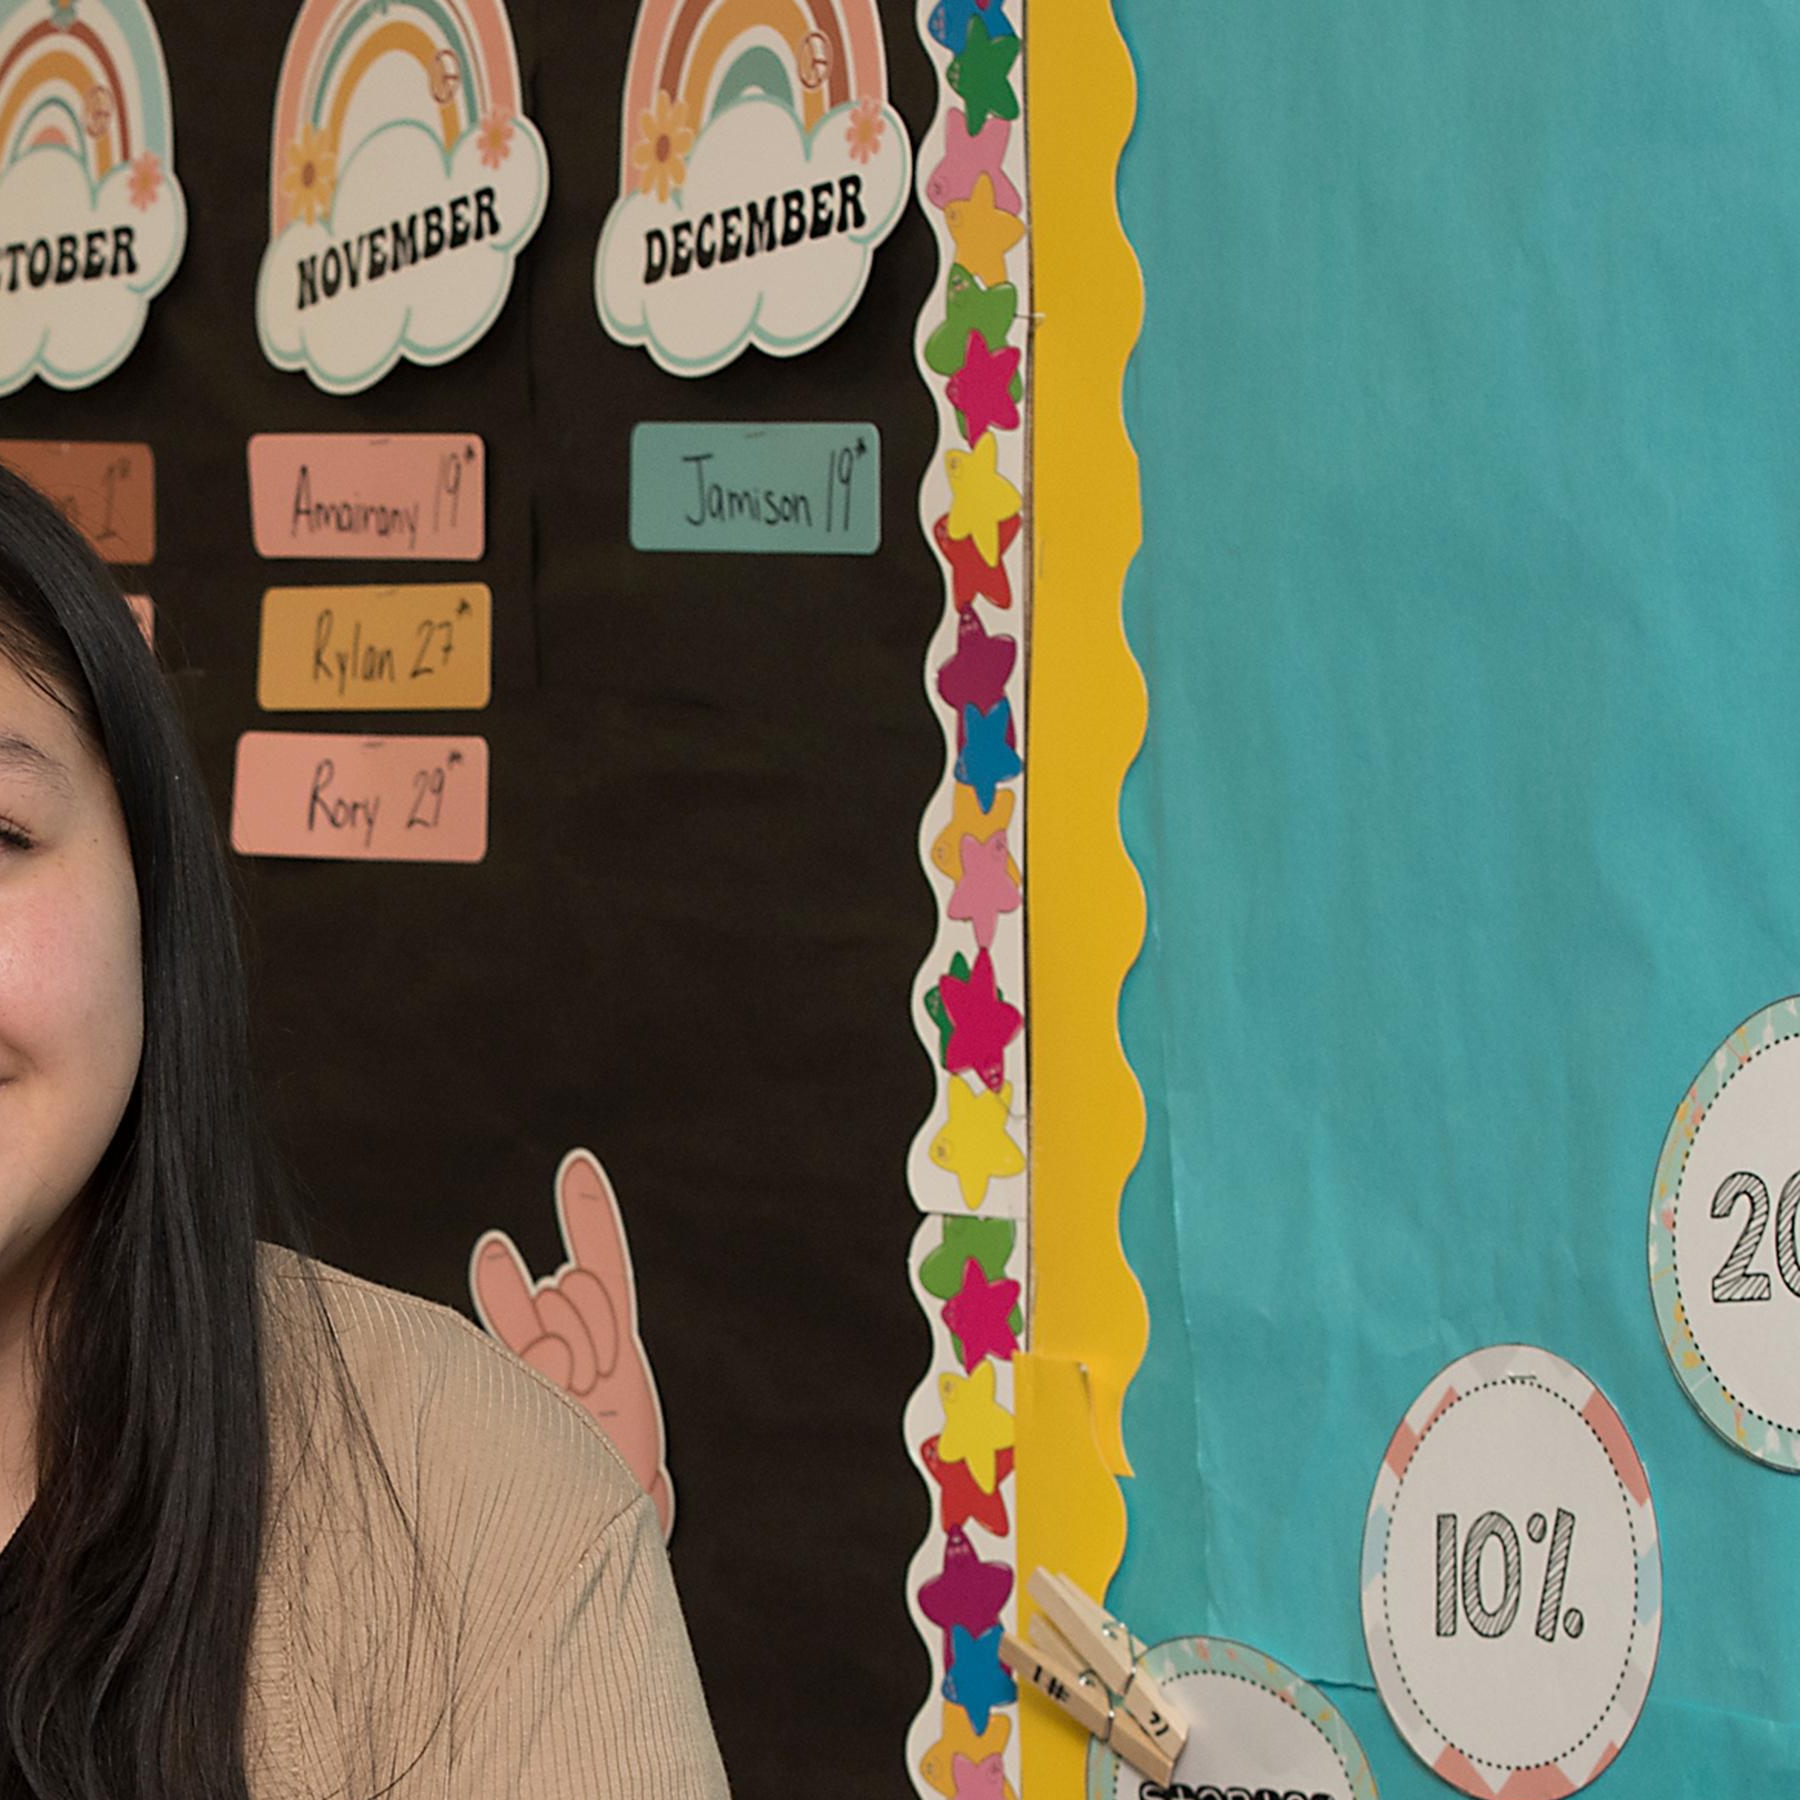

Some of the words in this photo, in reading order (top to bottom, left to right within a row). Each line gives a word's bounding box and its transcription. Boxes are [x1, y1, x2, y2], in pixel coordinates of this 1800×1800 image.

[296, 186, 500, 310] NOVEMBER
[643, 174, 866, 285] DECEMBER
[682, 452, 813, 532] Jamison
[312, 608, 396, 695] Rylan
[308, 758, 379, 848] Rory
[1436, 1507, 1584, 1643] 10%
